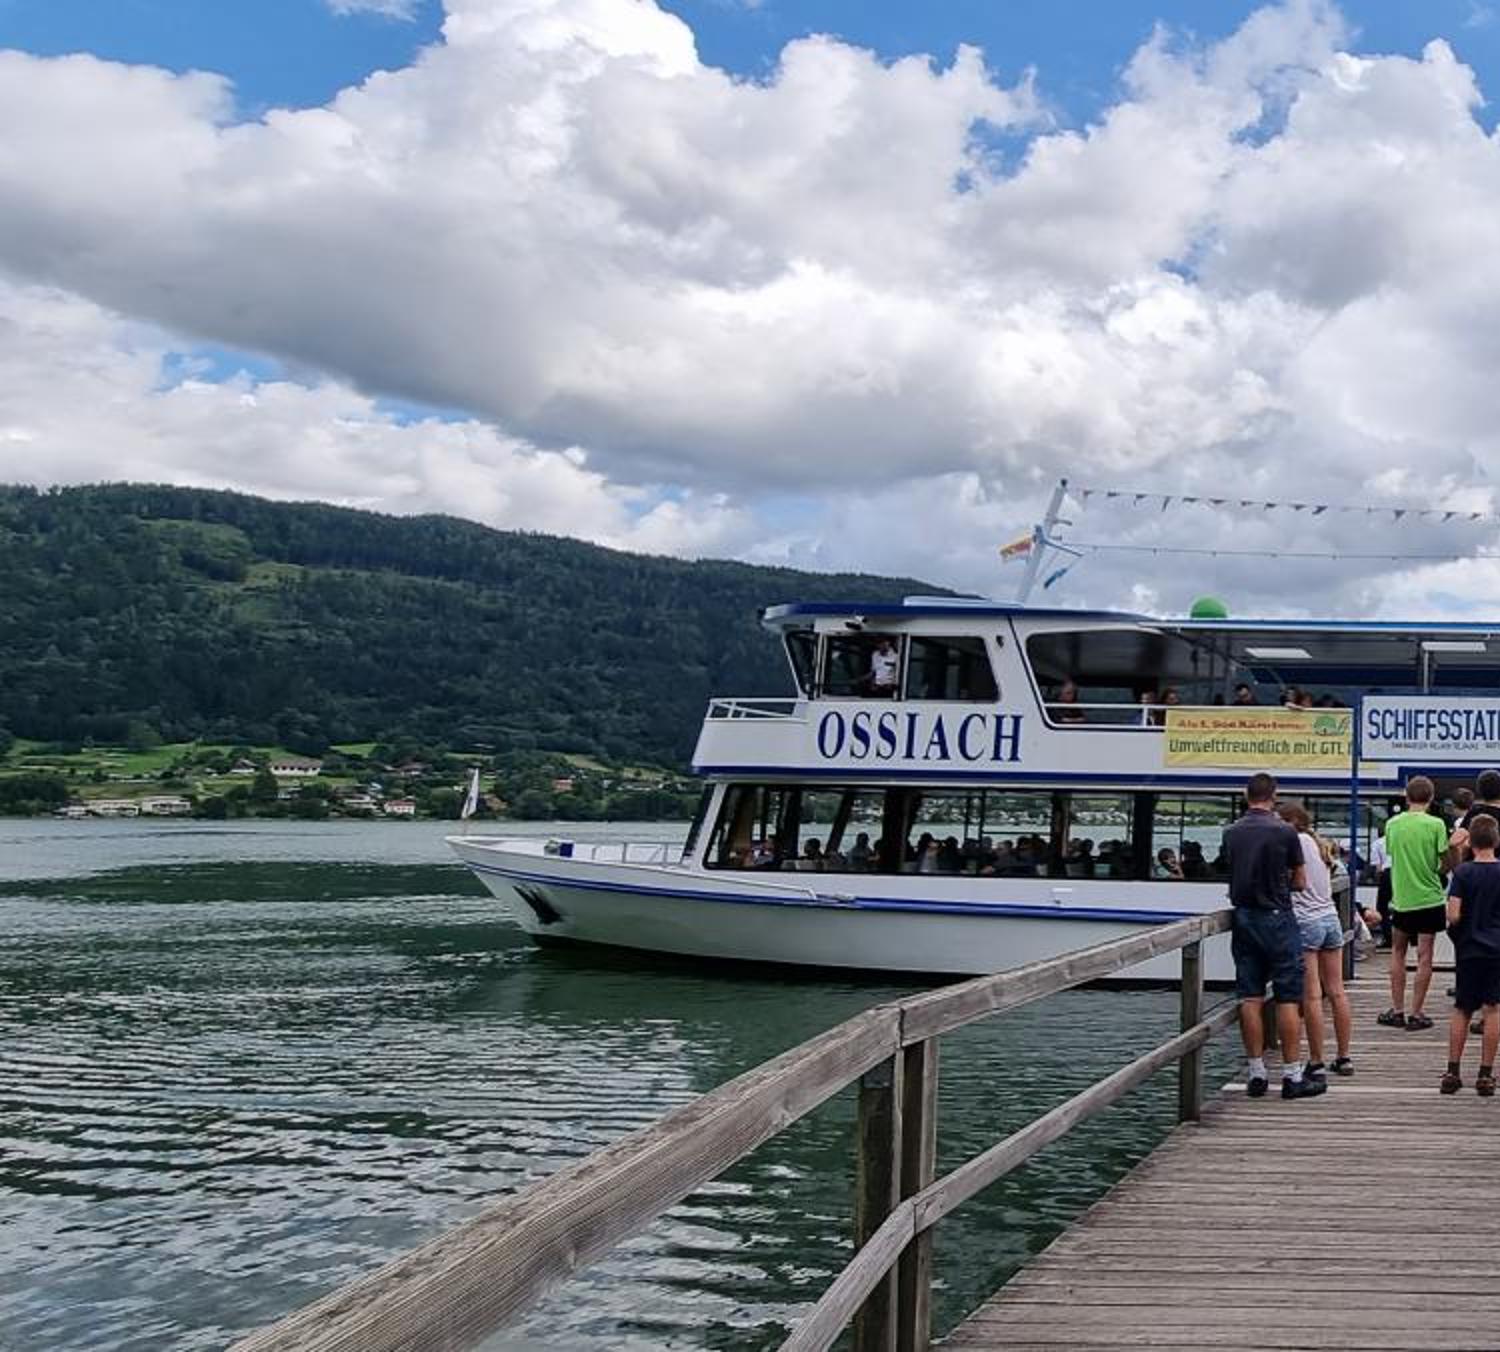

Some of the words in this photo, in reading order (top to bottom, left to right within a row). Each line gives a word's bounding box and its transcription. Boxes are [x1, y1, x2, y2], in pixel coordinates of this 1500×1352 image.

[818, 711, 1024, 762] OSSIACH
[1169, 738, 1291, 755] Umweltfreundlich
[1293, 741, 1317, 755] mit
[1320, 742, 1345, 756] GTL
